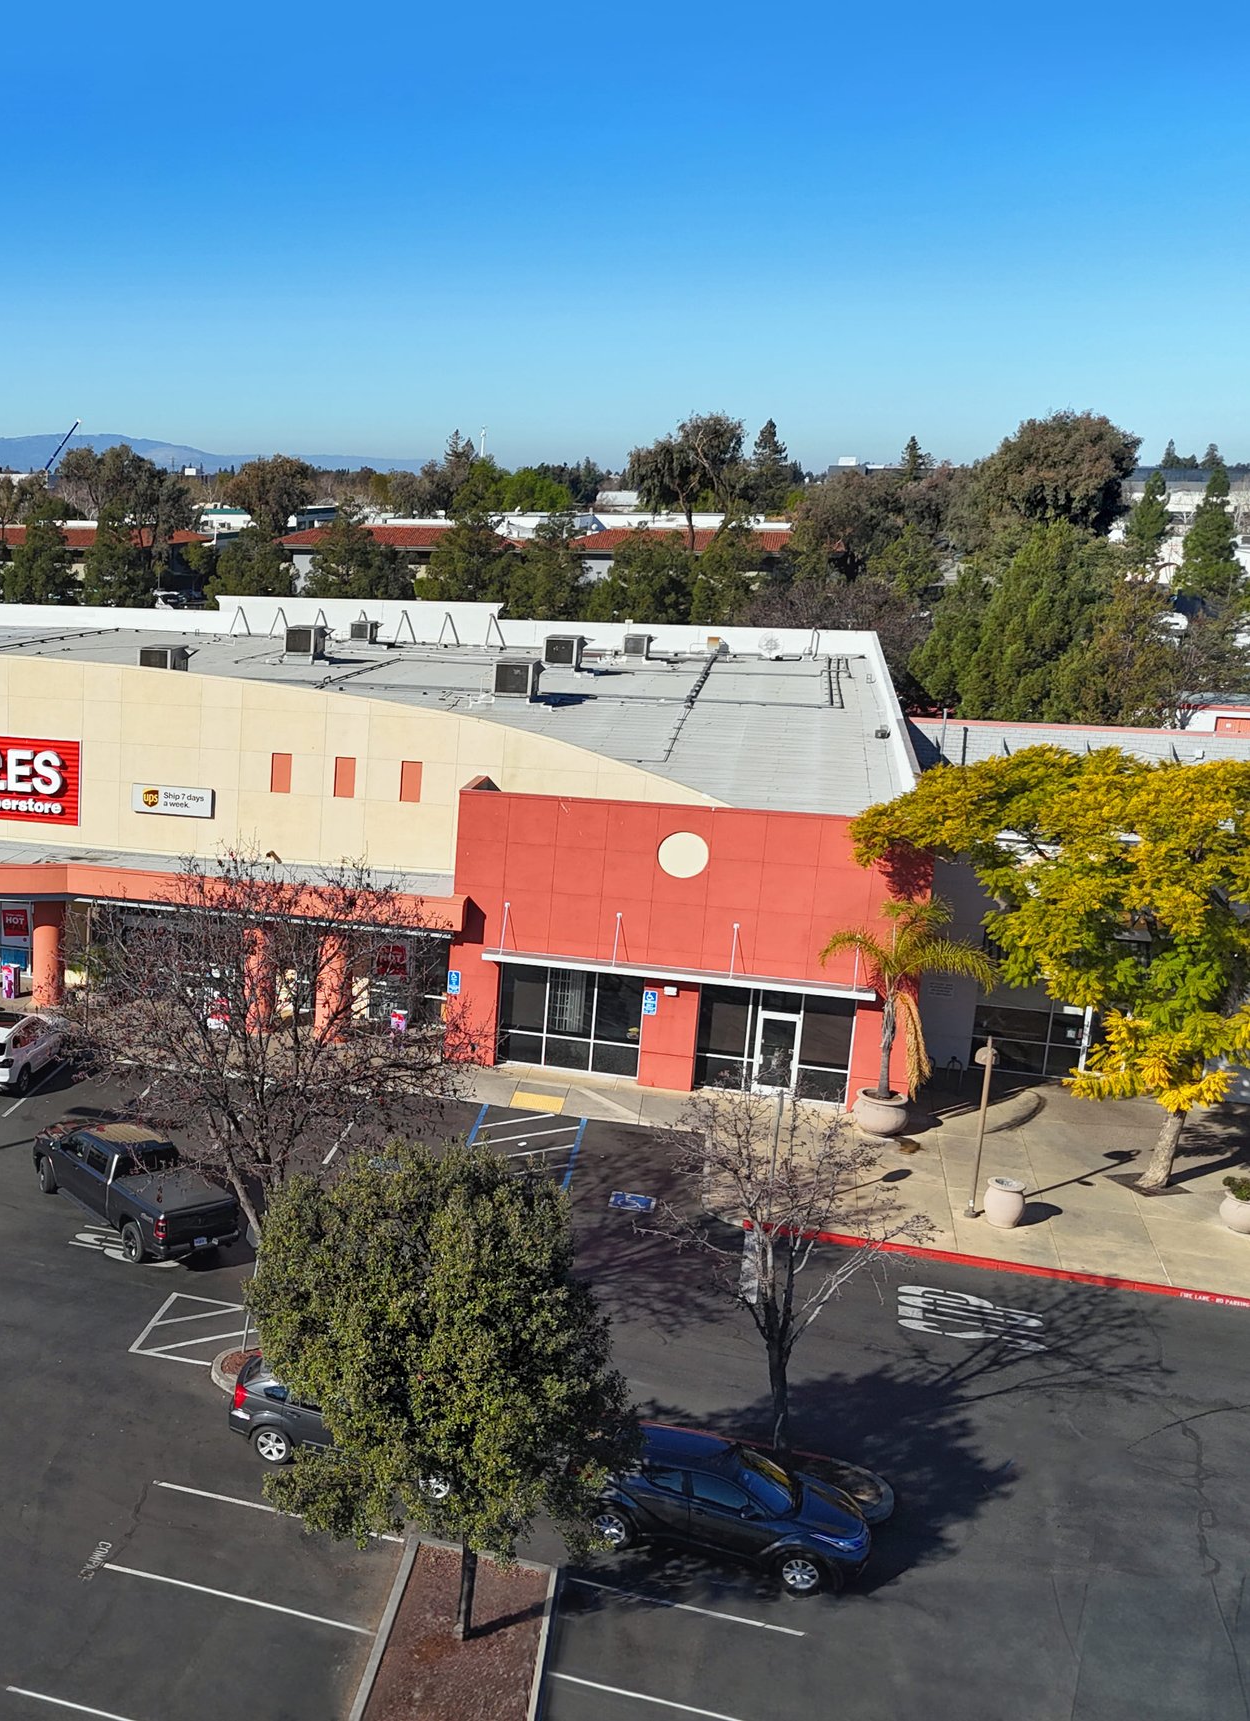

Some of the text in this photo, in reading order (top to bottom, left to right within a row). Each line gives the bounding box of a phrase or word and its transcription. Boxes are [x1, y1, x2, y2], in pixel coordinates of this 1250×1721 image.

[143, 793, 158, 805] ups
[163, 792, 180, 801] Ship
[187, 794, 204, 803] days
[5, 916, 25, 925] HOT
[898, 1285, 1048, 1351] STOP
